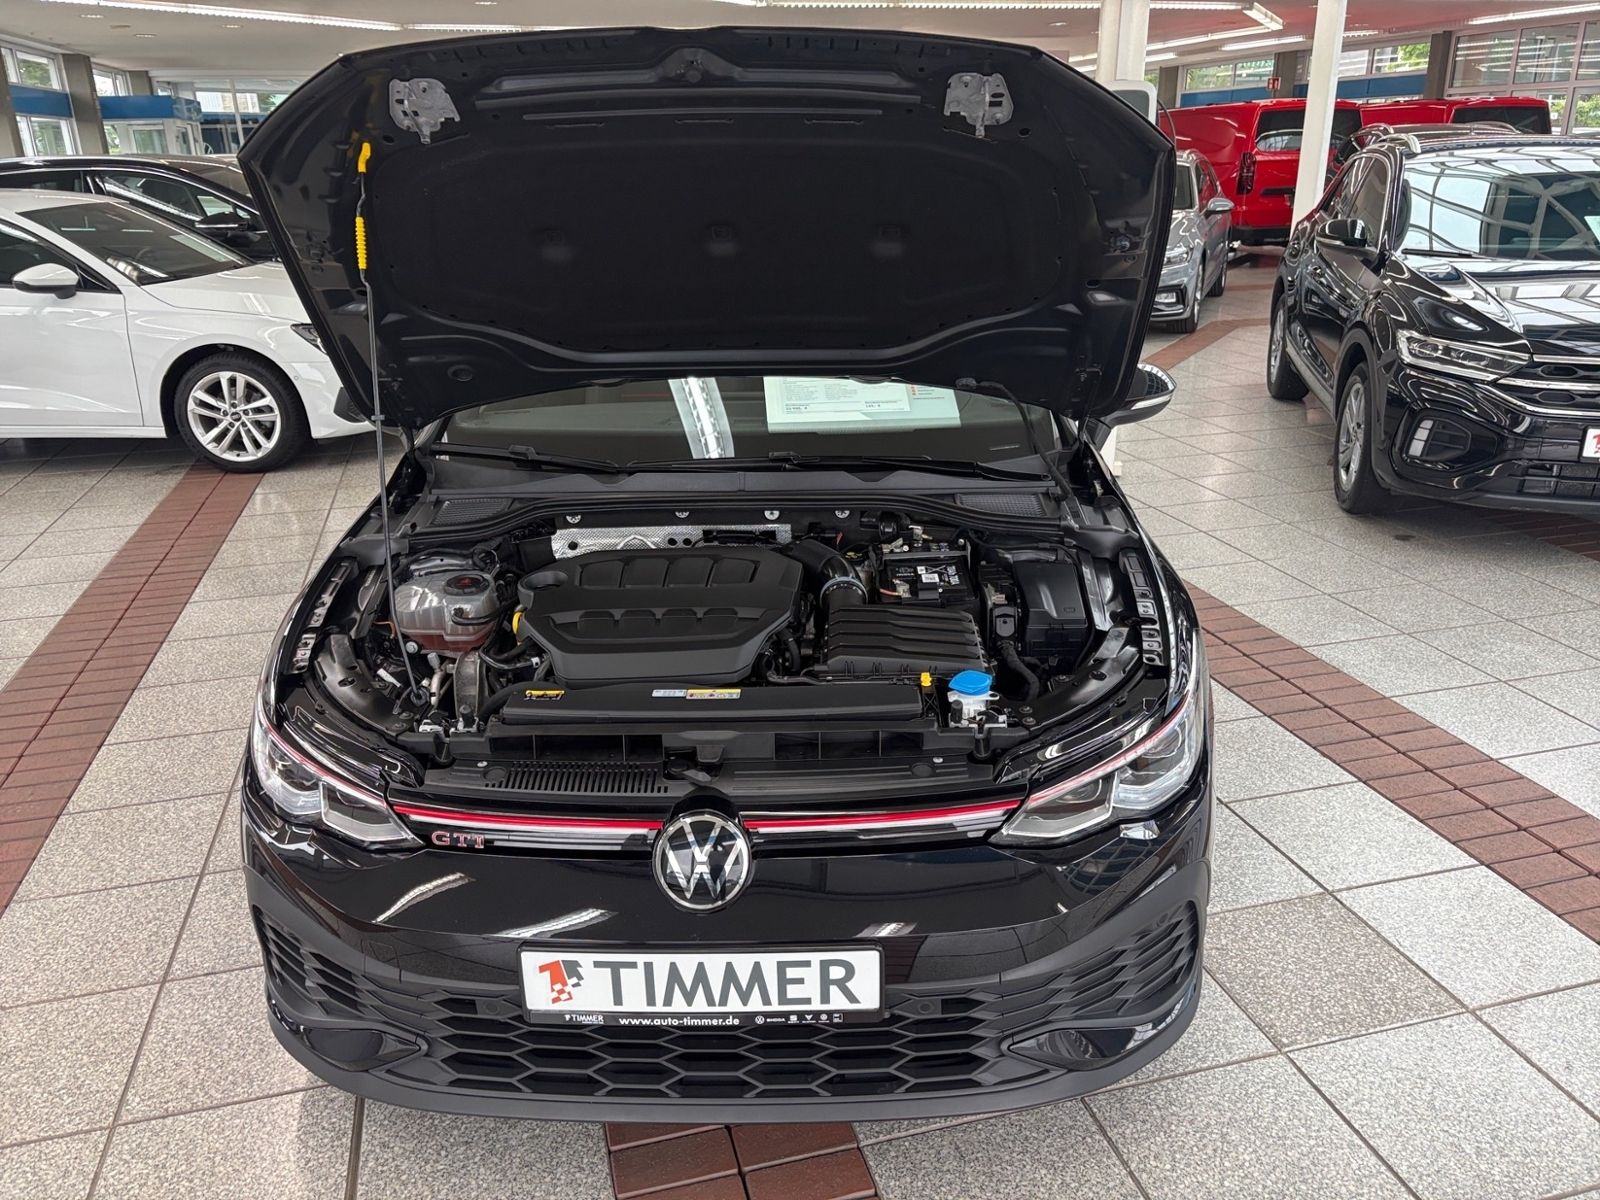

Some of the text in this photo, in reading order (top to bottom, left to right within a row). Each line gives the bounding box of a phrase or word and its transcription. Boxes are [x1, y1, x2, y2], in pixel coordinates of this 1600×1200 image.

[431, 831, 485, 849] GTI
[592, 958, 862, 1008] TIMMER
[571, 1014, 604, 1023] TIMMER
[619, 1015, 740, 1026] www.auto-timmer.de
